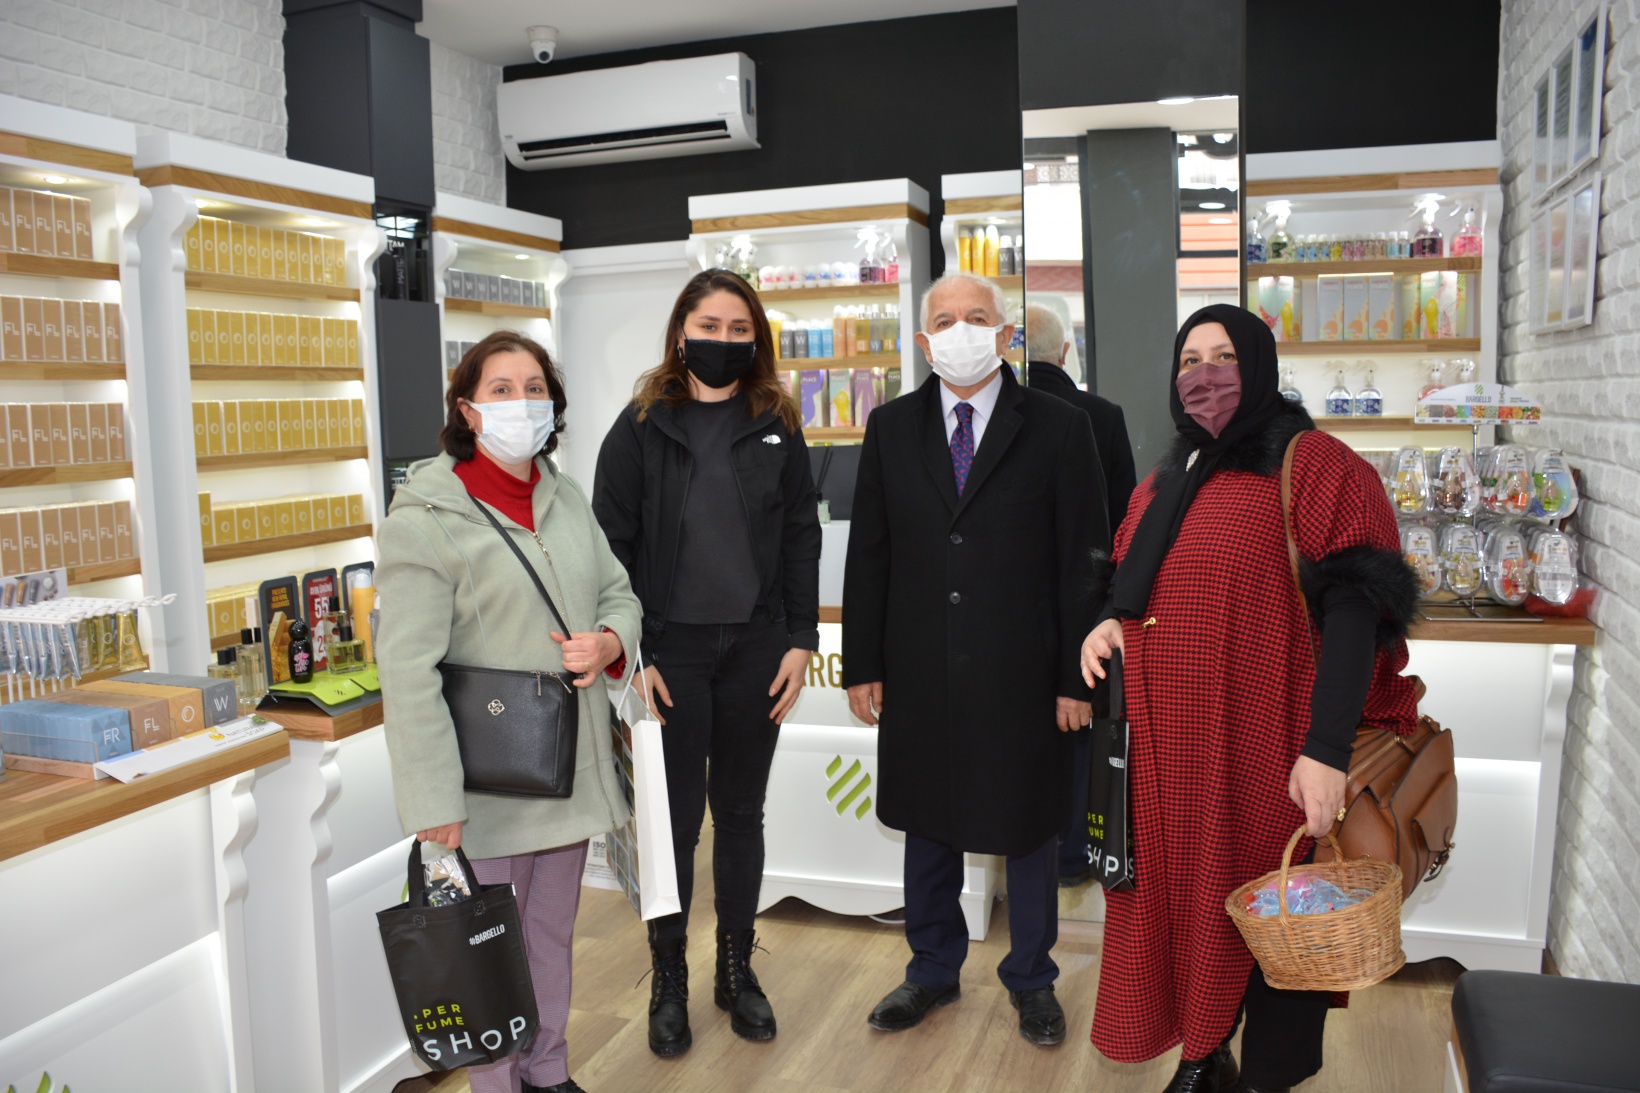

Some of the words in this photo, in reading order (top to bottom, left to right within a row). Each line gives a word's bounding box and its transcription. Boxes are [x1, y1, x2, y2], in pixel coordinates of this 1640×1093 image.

[17, 214, 31, 229] FL
[36, 217, 51, 232] FL
[57, 220, 71, 234] FL
[76, 222, 90, 237] FL
[999, 253, 1009, 262] W
[4, 321, 19, 335] FL
[26, 323, 41, 337] FL
[46, 324, 60, 337] FL
[66, 325, 80, 338] FL
[85, 325, 99, 338] FL
[107, 327, 119, 339] FL
[781, 337, 791, 346] W
[795, 336, 806, 345] W
[12, 430, 27, 442] FL
[34, 429, 48, 442] FL
[53, 428, 67, 441] FL
[72, 427, 86, 440] FL
[91, 427, 105, 439] FL
[110, 426, 122, 439] FL
[82, 529, 95, 541] FL
[101, 527, 113, 539] FL
[117, 524, 130, 537] FL
[24, 536, 38, 549] FL
[45, 533, 58, 546] FL
[63, 531, 77, 544] FL
[2, 538, 17, 551] FL
[802, 652, 843, 689] RG
[213, 695, 229, 712] W
[144, 717, 160, 733] FL
[103, 727, 120, 745] FR
[1088, 826, 1104, 840] UME
[469, 923, 506, 946] #BARGELLO
[415, 1016, 465, 1034] FUME
[423, 1016, 528, 1061] SHOP
